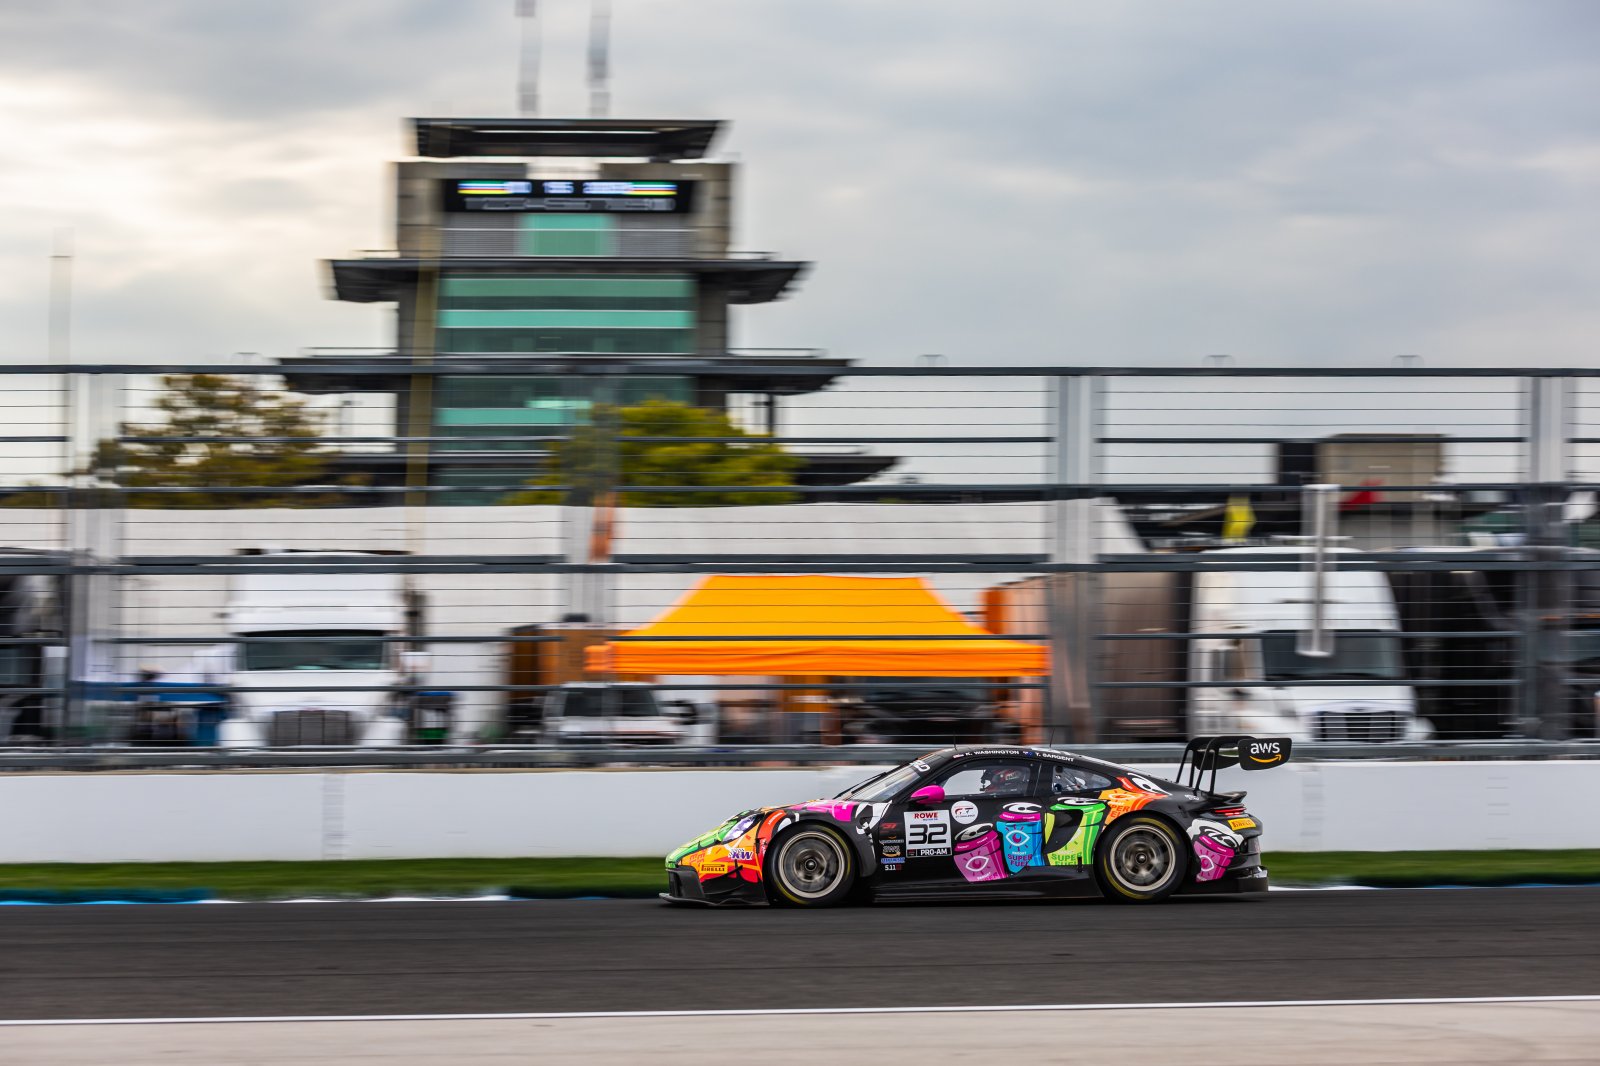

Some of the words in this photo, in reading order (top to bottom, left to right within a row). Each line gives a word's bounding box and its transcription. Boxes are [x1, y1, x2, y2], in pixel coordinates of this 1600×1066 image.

[1250, 742, 1280, 754] aws
[1042, 753, 1075, 762] SARGENT
[908, 823, 948, 845] 32
[730, 851, 753, 860] KW
[920, 848, 948, 856] PRO-AM
[1007, 853, 1033, 861] SUPER
[701, 864, 725, 872] PIRELLI
